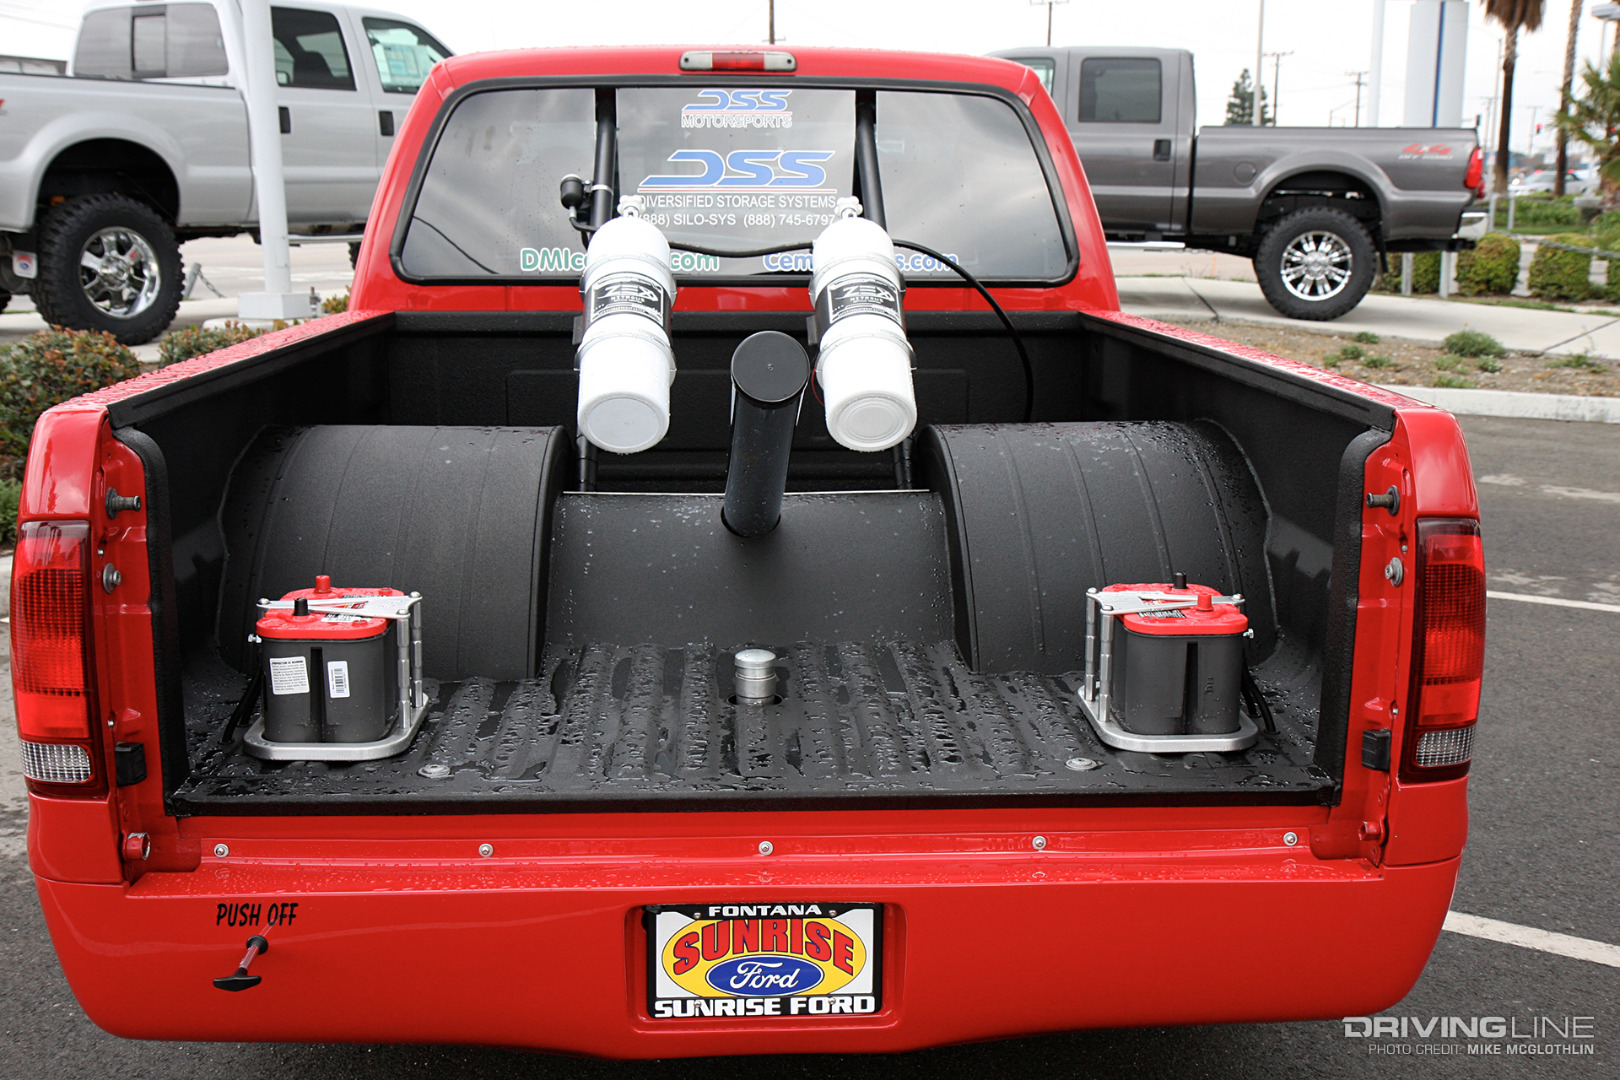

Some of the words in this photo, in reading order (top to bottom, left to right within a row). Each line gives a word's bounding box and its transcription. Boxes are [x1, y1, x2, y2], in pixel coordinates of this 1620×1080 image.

[681, 89, 793, 111] DSS
[681, 114, 793, 128] MOTORSPORTS
[638, 150, 836, 187] DSS
[640, 195, 714, 208] DIVERSIFIED
[717, 195, 776, 208] STORAGE
[779, 196, 836, 208] SYSTEMS
[673, 213, 736, 225] SILO-SYS
[743, 213, 776, 228] (888)
[779, 214, 836, 226] 745-6797
[216, 903, 262, 927] PUSH
[267, 903, 299, 926] OFF
[708, 904, 822, 917] FONTANA
[673, 918, 854, 976] SUNRISE
[729, 962, 801, 989] Ford
[654, 997, 781, 1018] SUNRISE
[790, 996, 875, 1014] FORD
